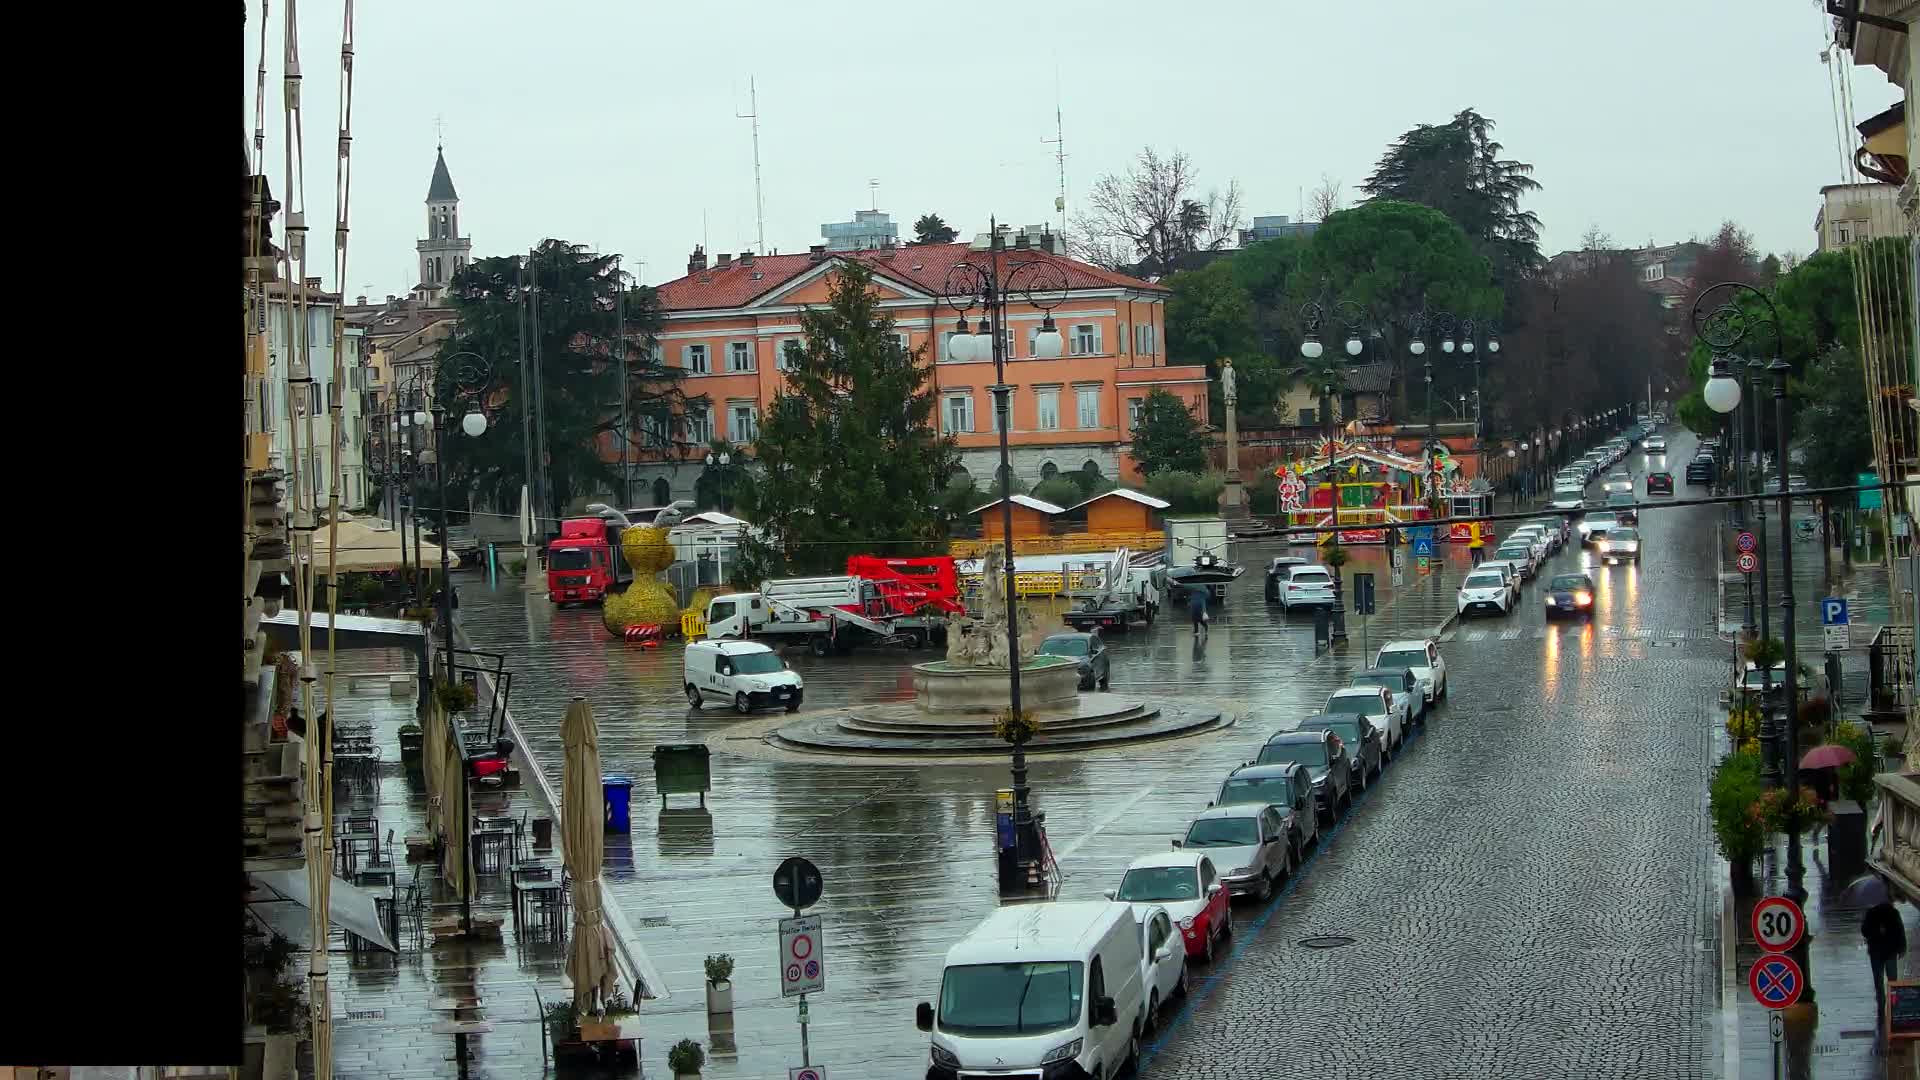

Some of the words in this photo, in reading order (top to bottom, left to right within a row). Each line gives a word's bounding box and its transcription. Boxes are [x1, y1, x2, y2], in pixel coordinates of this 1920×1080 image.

[1742, 557, 1753, 567] 20
[1827, 602, 1842, 622] P
[1762, 911, 1792, 938] 30
[790, 970, 799, 978] 10
